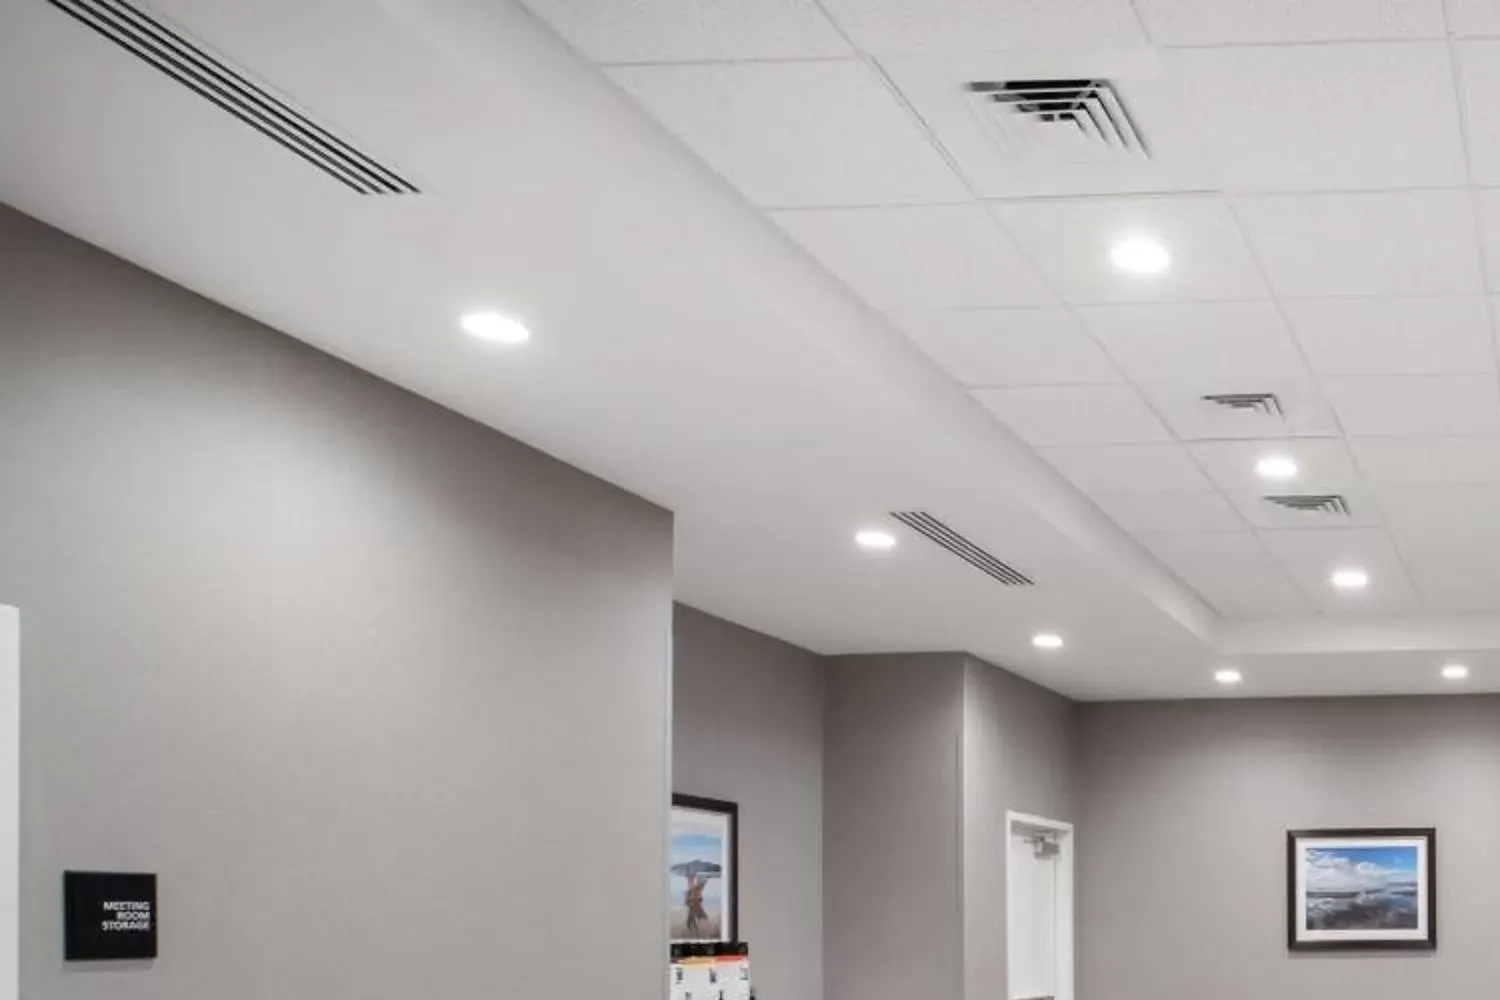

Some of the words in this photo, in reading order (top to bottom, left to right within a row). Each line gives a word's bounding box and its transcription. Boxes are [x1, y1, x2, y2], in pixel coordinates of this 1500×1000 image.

[103, 901, 150, 910] MEETING
[116, 911, 150, 920] ROOM
[102, 921, 150, 931] STORAGE
